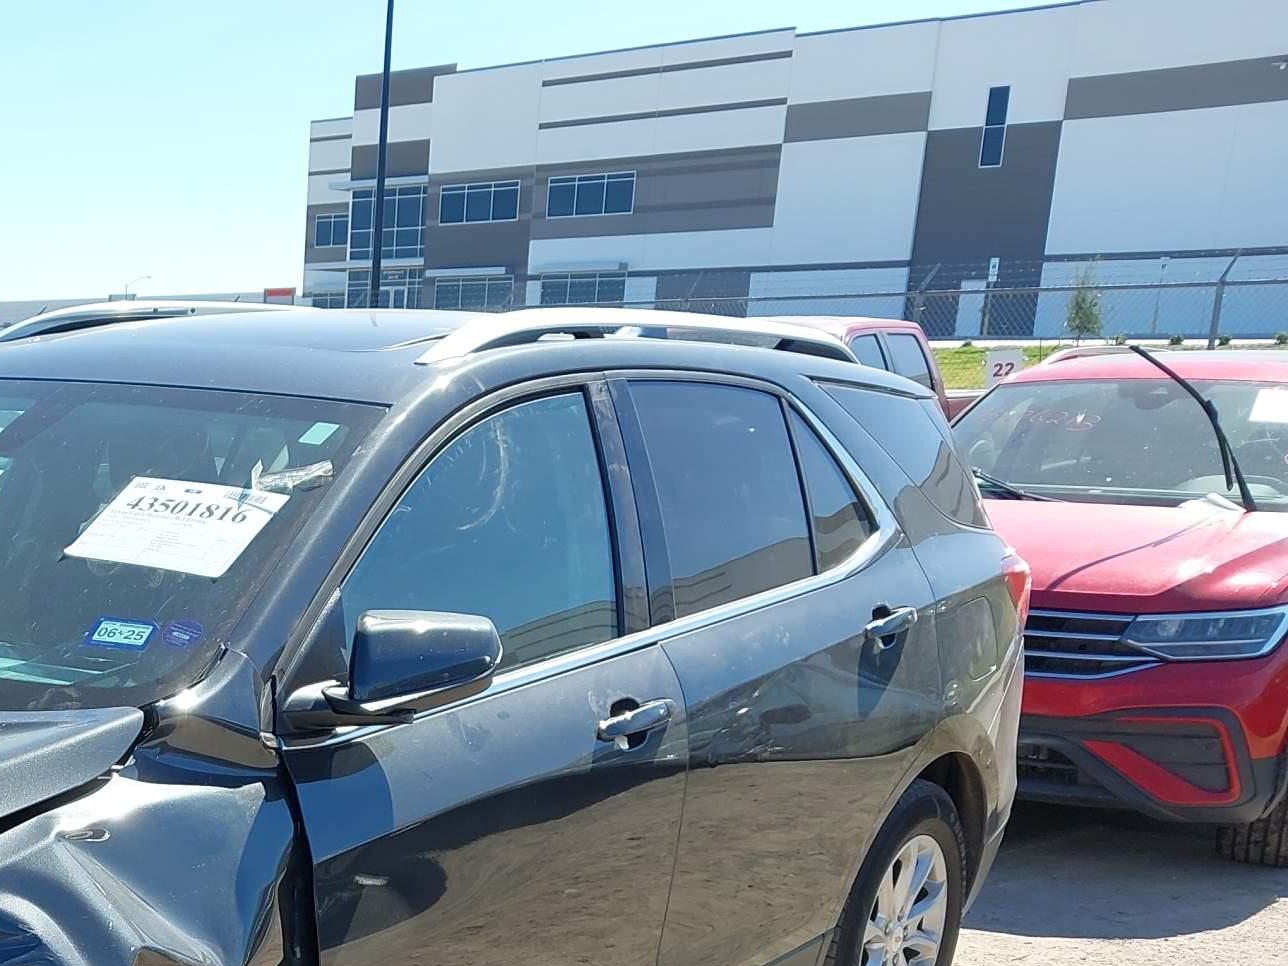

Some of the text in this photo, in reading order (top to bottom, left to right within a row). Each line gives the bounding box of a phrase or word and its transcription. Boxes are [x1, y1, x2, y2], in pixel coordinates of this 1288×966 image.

[992, 362, 1015, 378] 22
[126, 496, 253, 523] 43501816
[97, 627, 146, 641] 06 25
